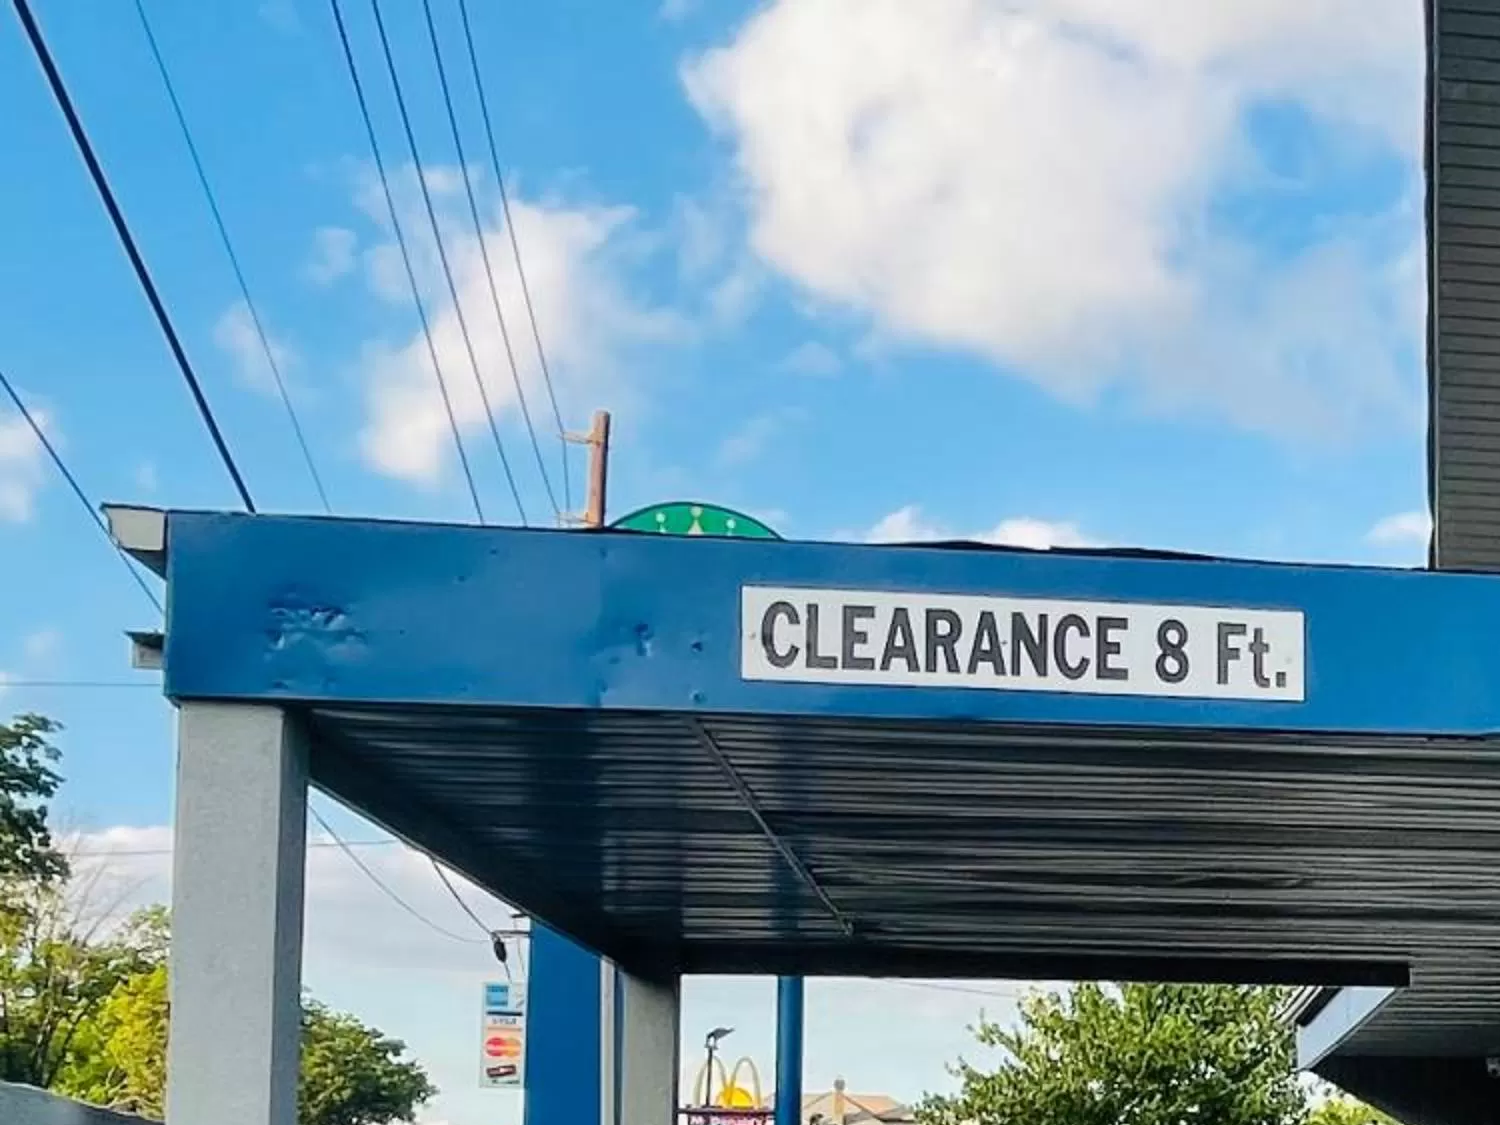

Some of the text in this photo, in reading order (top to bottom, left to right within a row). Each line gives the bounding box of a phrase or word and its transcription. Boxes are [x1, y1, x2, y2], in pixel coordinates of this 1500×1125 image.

[760, 600, 1287, 689] CLEARANCE 8 Ft.
